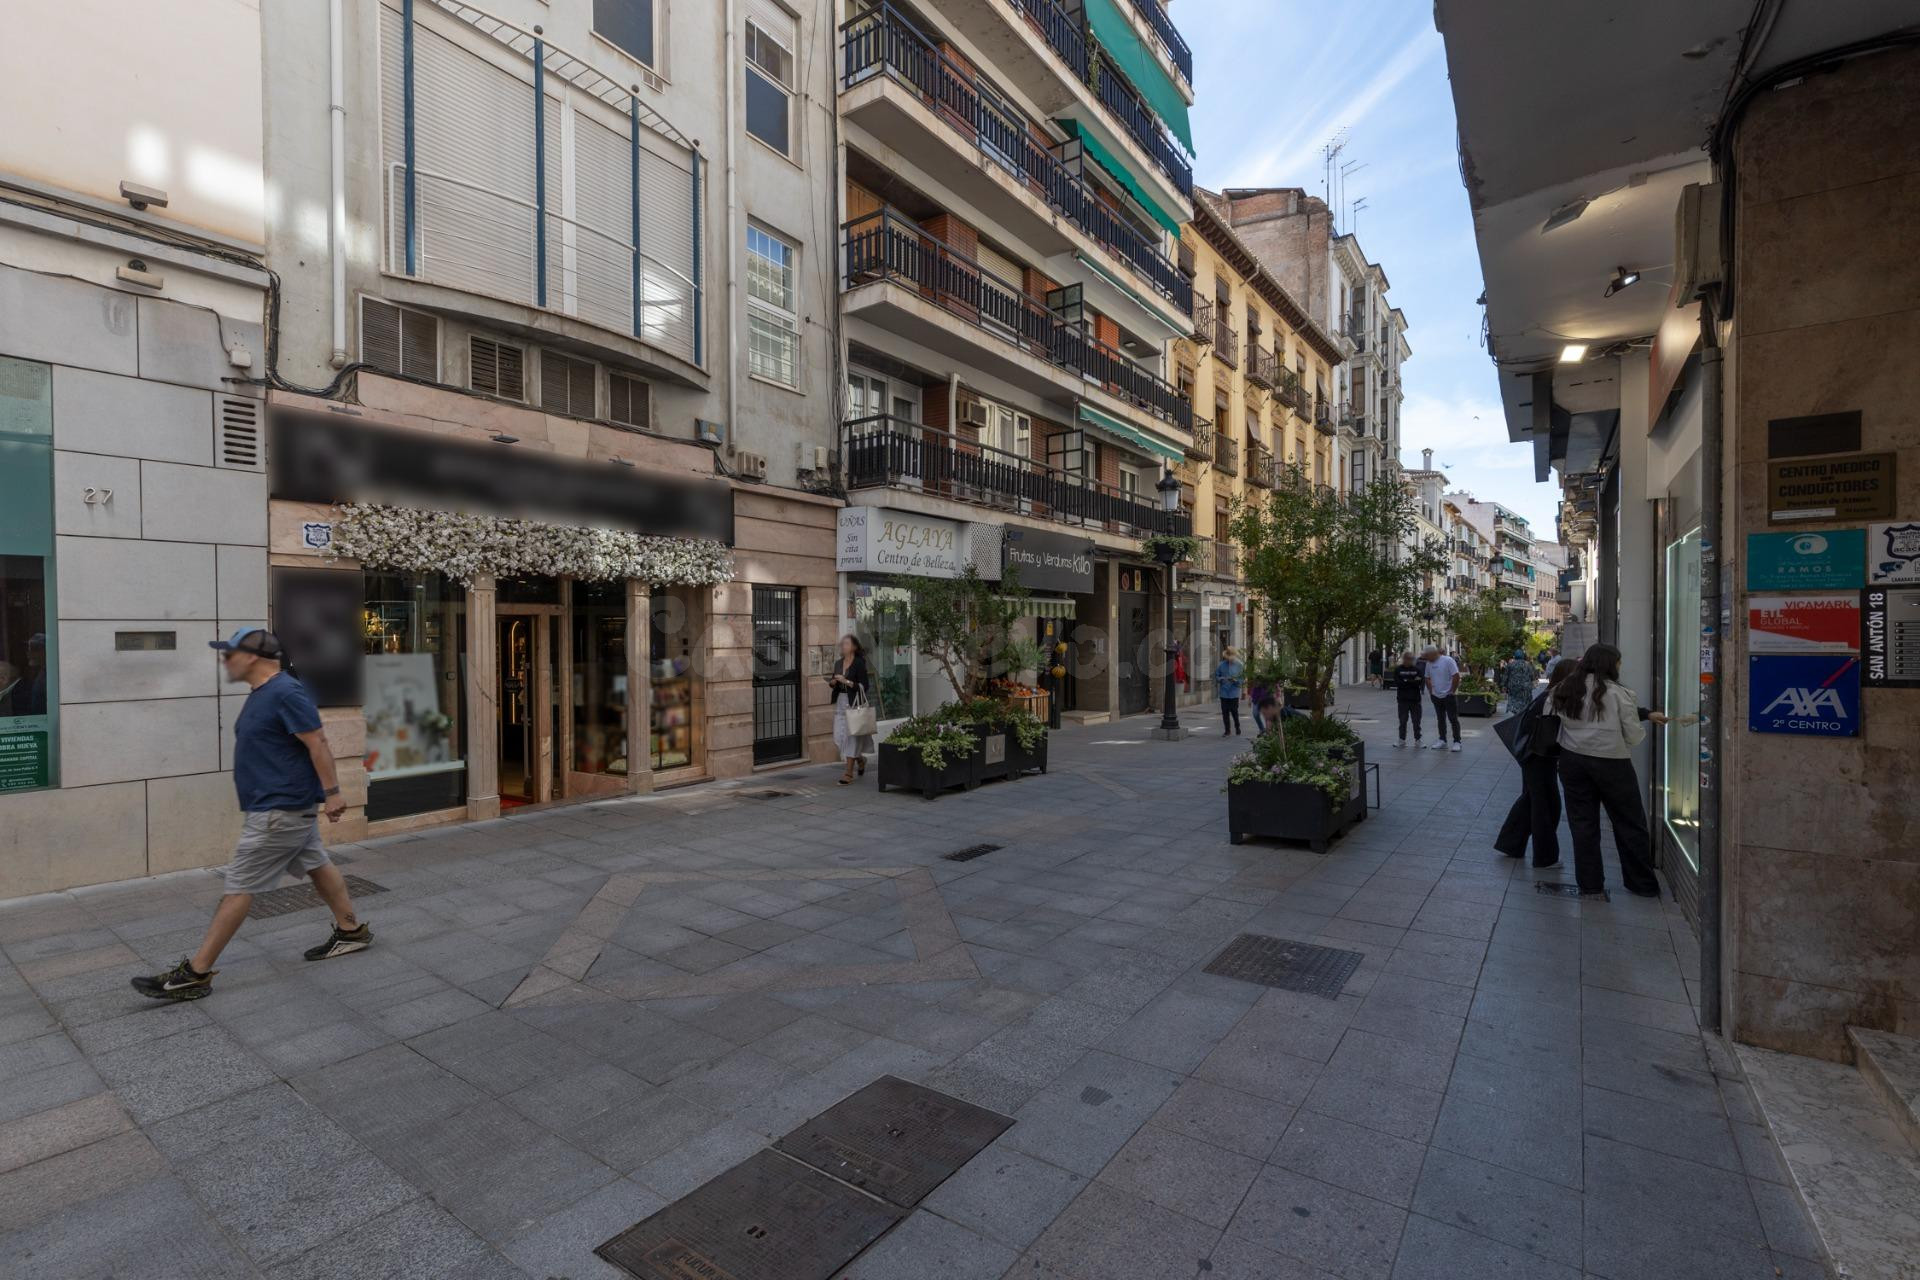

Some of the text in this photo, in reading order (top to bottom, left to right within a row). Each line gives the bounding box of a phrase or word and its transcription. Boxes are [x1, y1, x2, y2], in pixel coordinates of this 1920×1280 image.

[1779, 464, 1827, 478] CENTRO
[1778, 478, 1879, 497] CONDUCTORES
[83, 486, 114, 505] 27
[839, 514, 864, 528] UÑAS
[845, 533, 858, 543] Sin
[877, 521, 953, 551] AGLAYA
[845, 543, 859, 553] cita
[841, 556, 863, 567] previa
[877, 549, 909, 566] Centro
[911, 552, 921, 567] de
[1009, 547, 1091, 575] Frutas y Verduras Killo
[1778, 565, 1832, 574] RAMOS
[1785, 600, 1853, 609] VICAMARK
[1760, 608, 1784, 618] ETL
[1760, 617, 1802, 626] GLOBAL
[1866, 592, 1884, 680] SAN ANTÓN 18
[1760, 687, 1848, 719] AXA
[1788, 719, 1841, 731] CENTRO
